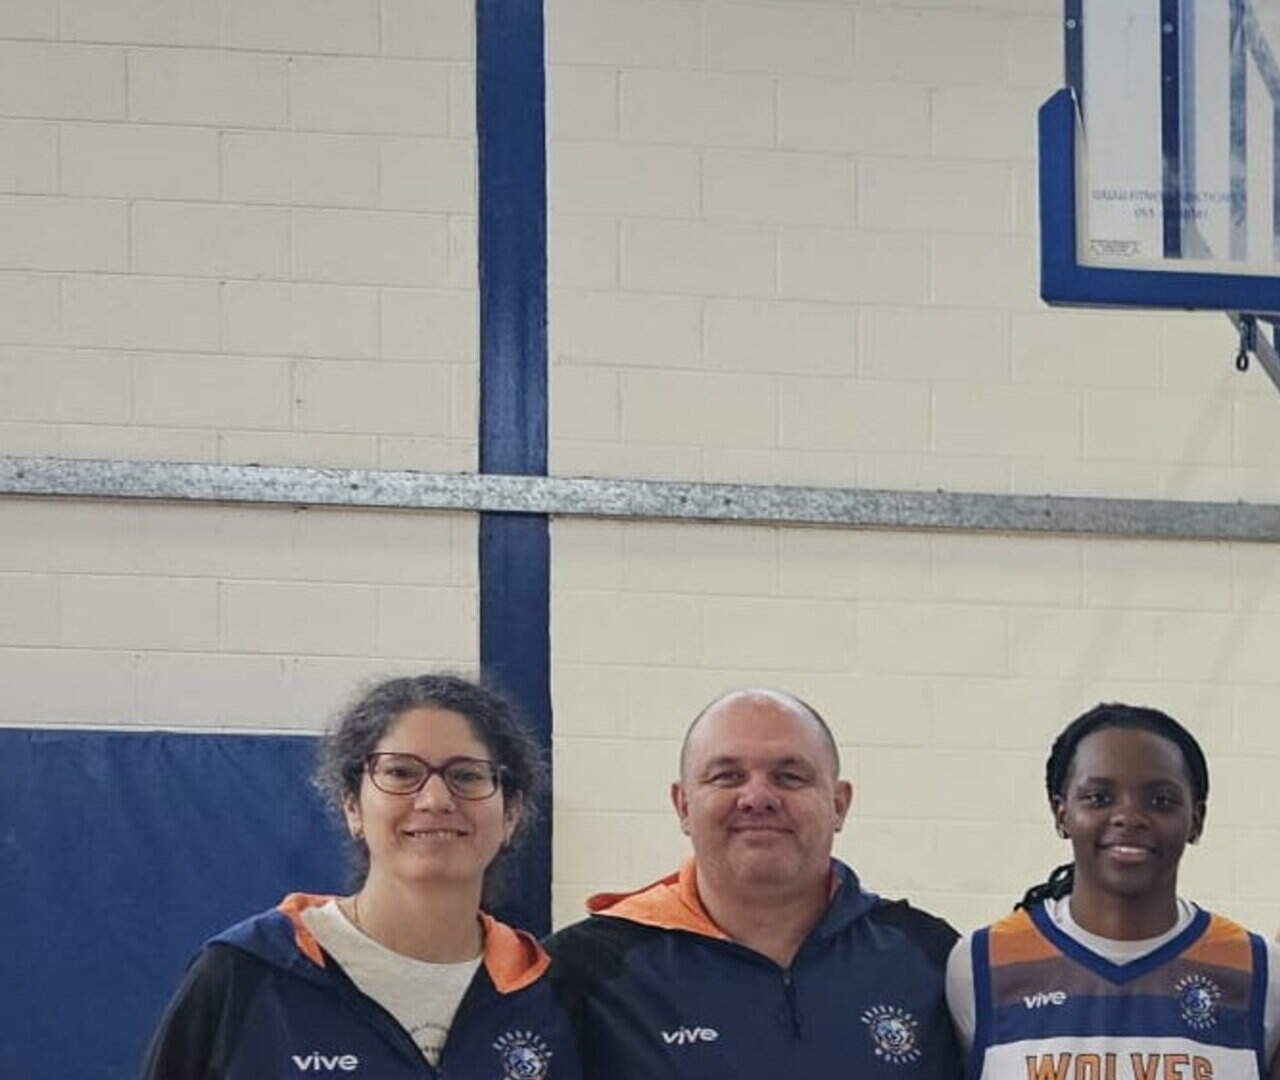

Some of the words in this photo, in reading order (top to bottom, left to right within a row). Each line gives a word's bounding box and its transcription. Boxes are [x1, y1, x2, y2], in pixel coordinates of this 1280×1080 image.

[1023, 989, 1066, 1009] vive
[661, 1027, 718, 1045] vive
[292, 1052, 357, 1071] vive
